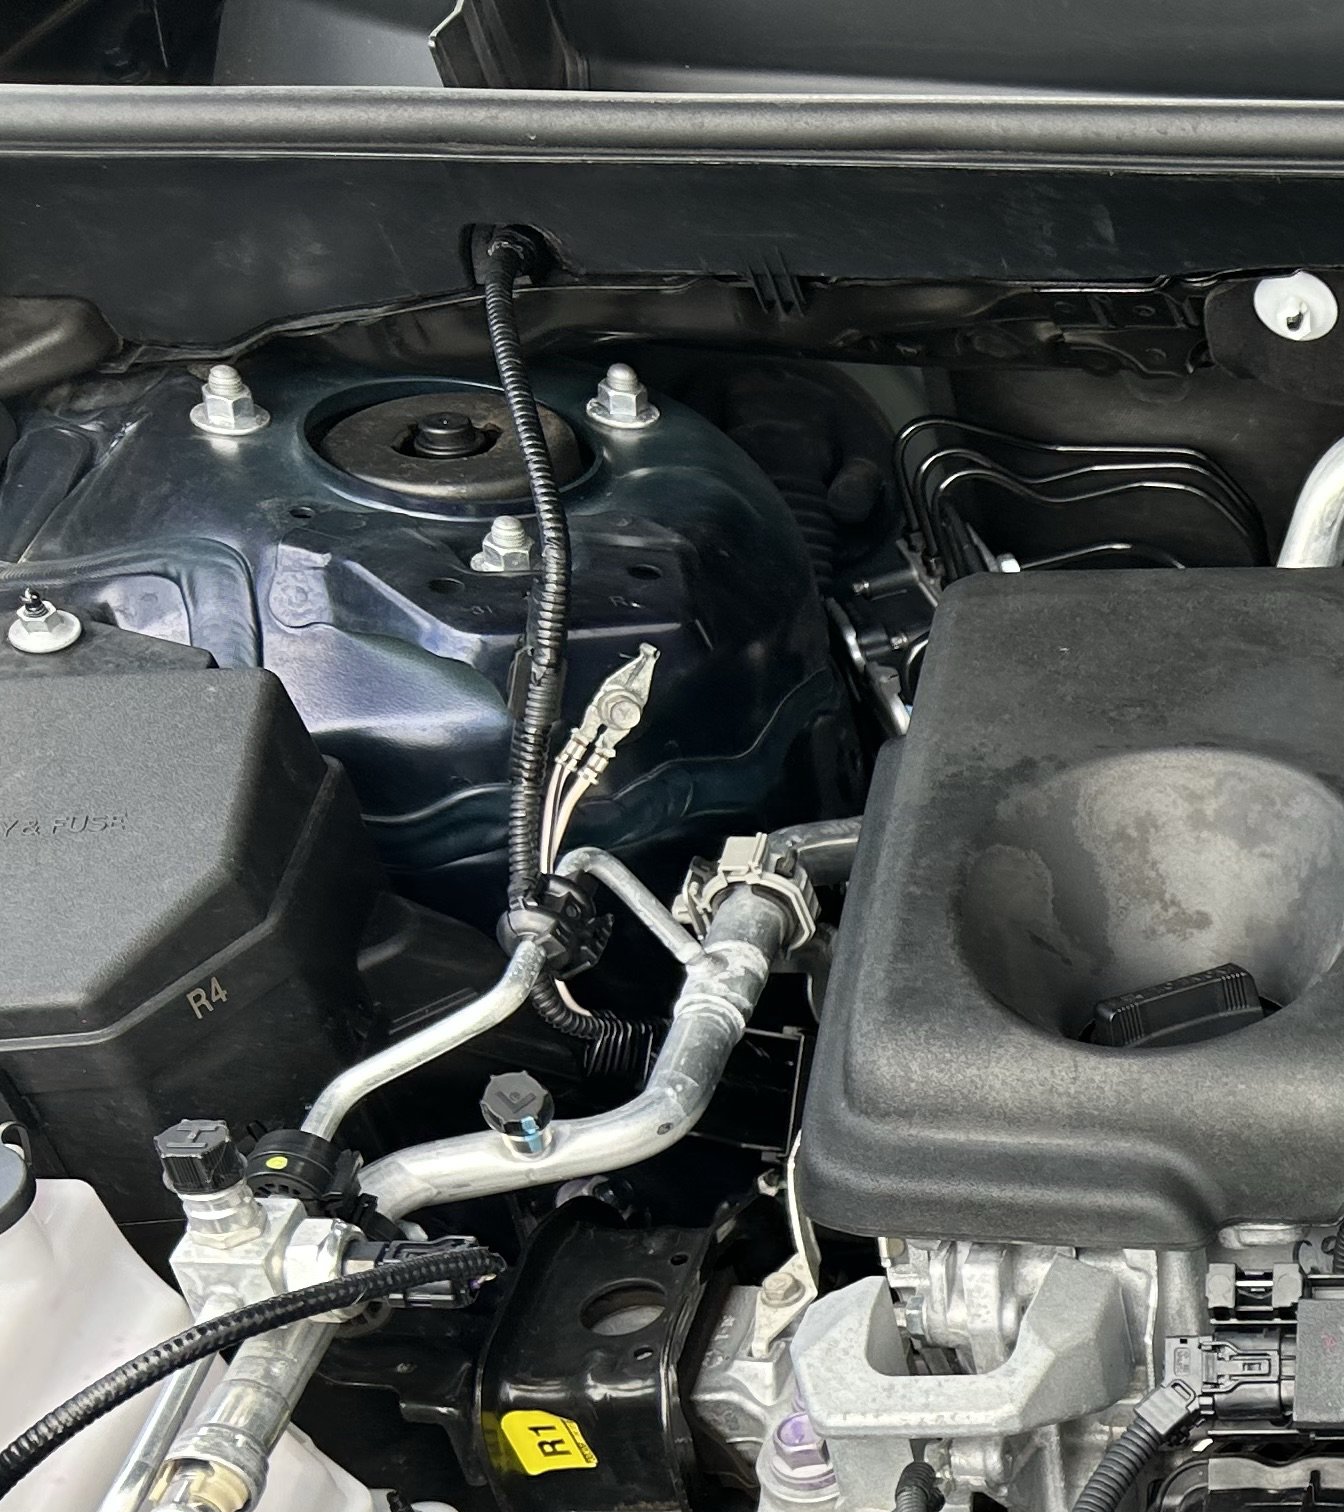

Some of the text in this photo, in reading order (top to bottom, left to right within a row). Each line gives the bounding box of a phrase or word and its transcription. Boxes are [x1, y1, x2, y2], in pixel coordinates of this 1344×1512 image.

[185, 976, 229, 1021] R4
[165, 1124, 218, 1149] H
[527, 1425, 573, 1458] R1
